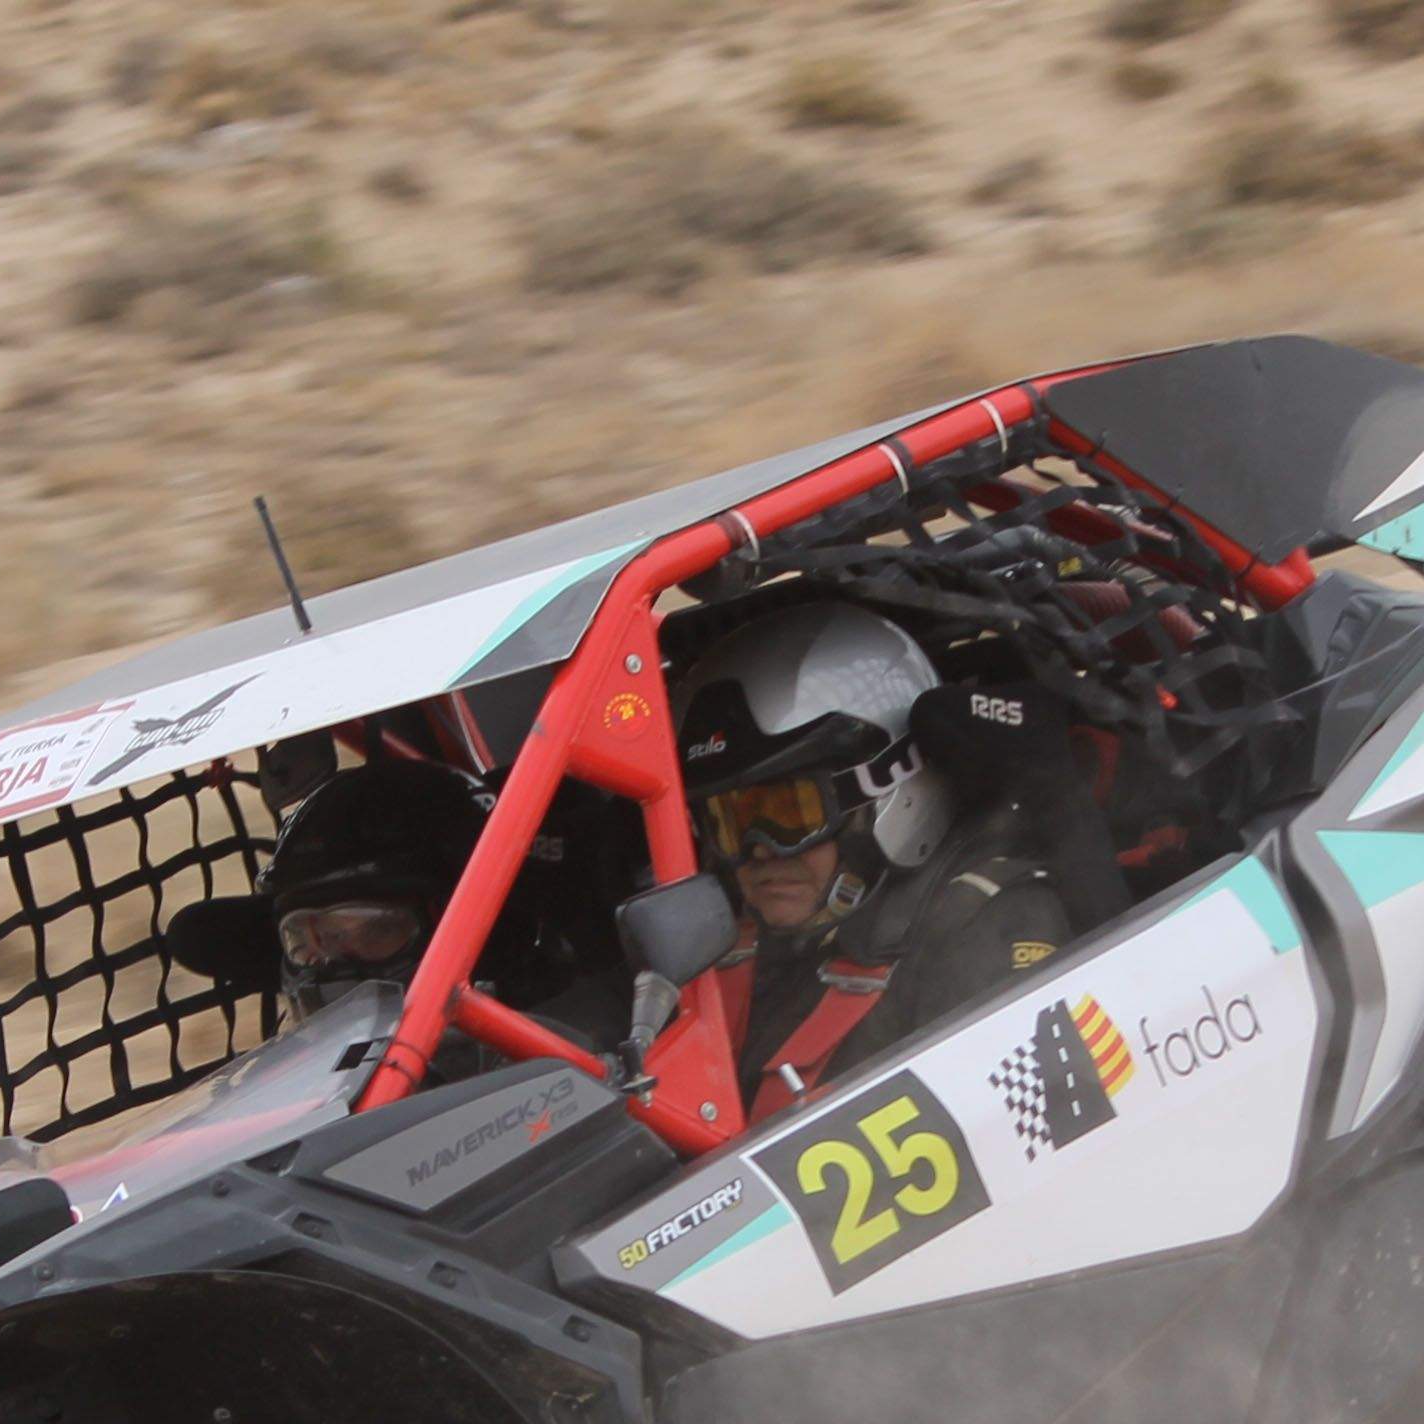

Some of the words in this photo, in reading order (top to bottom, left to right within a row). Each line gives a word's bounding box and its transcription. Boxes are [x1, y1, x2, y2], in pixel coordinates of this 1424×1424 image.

[10, 734, 67, 759] TIERRA
[970, 694, 1023, 725] RRS
[1139, 985, 1263, 1088] fada
[406, 1098, 539, 1188] MAVERICK
[539, 1077, 574, 1110] X3
[796, 1096, 960, 1265] 25
